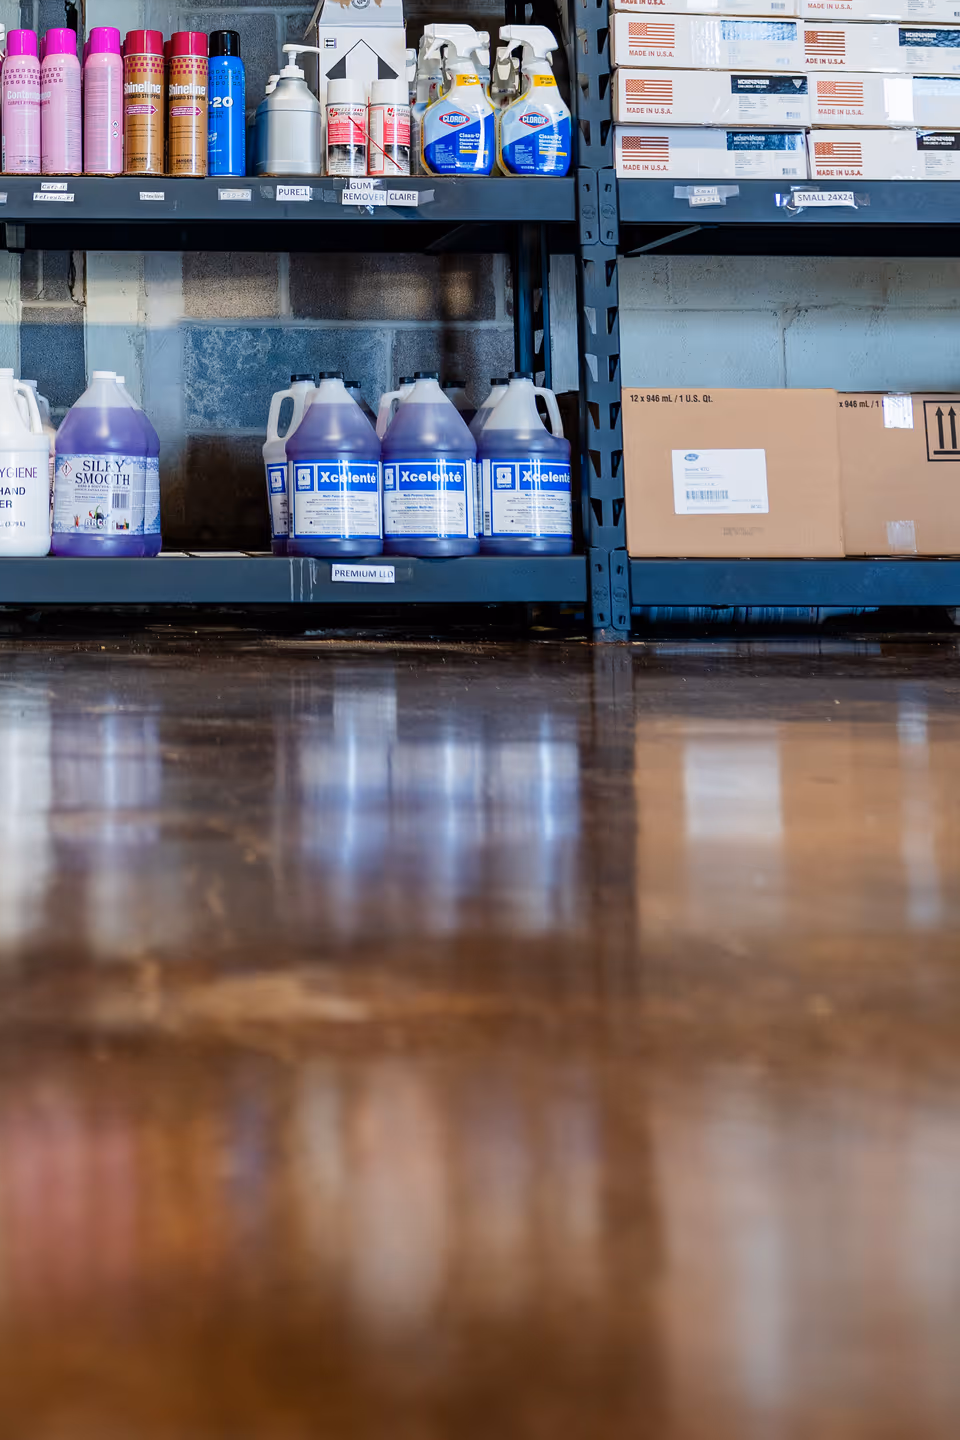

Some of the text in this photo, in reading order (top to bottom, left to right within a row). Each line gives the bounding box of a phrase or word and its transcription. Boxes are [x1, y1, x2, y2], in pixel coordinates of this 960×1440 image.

[522, 116, 546, 124] CLOROX
[350, 182, 372, 190] GUM
[278, 188, 308, 196] PURELL
[344, 193, 384, 201] REMOVER
[798, 194, 826, 202] SMALL
[686, 394, 700, 402] U.S.
[702, 394, 714, 403] Qt.
[75, 472, 130, 486] SMOOTH
[320, 470, 376, 484] Xcelenté
[400, 470, 462, 483] Xcelenté
[334, 570, 376, 578] PREMIUM
